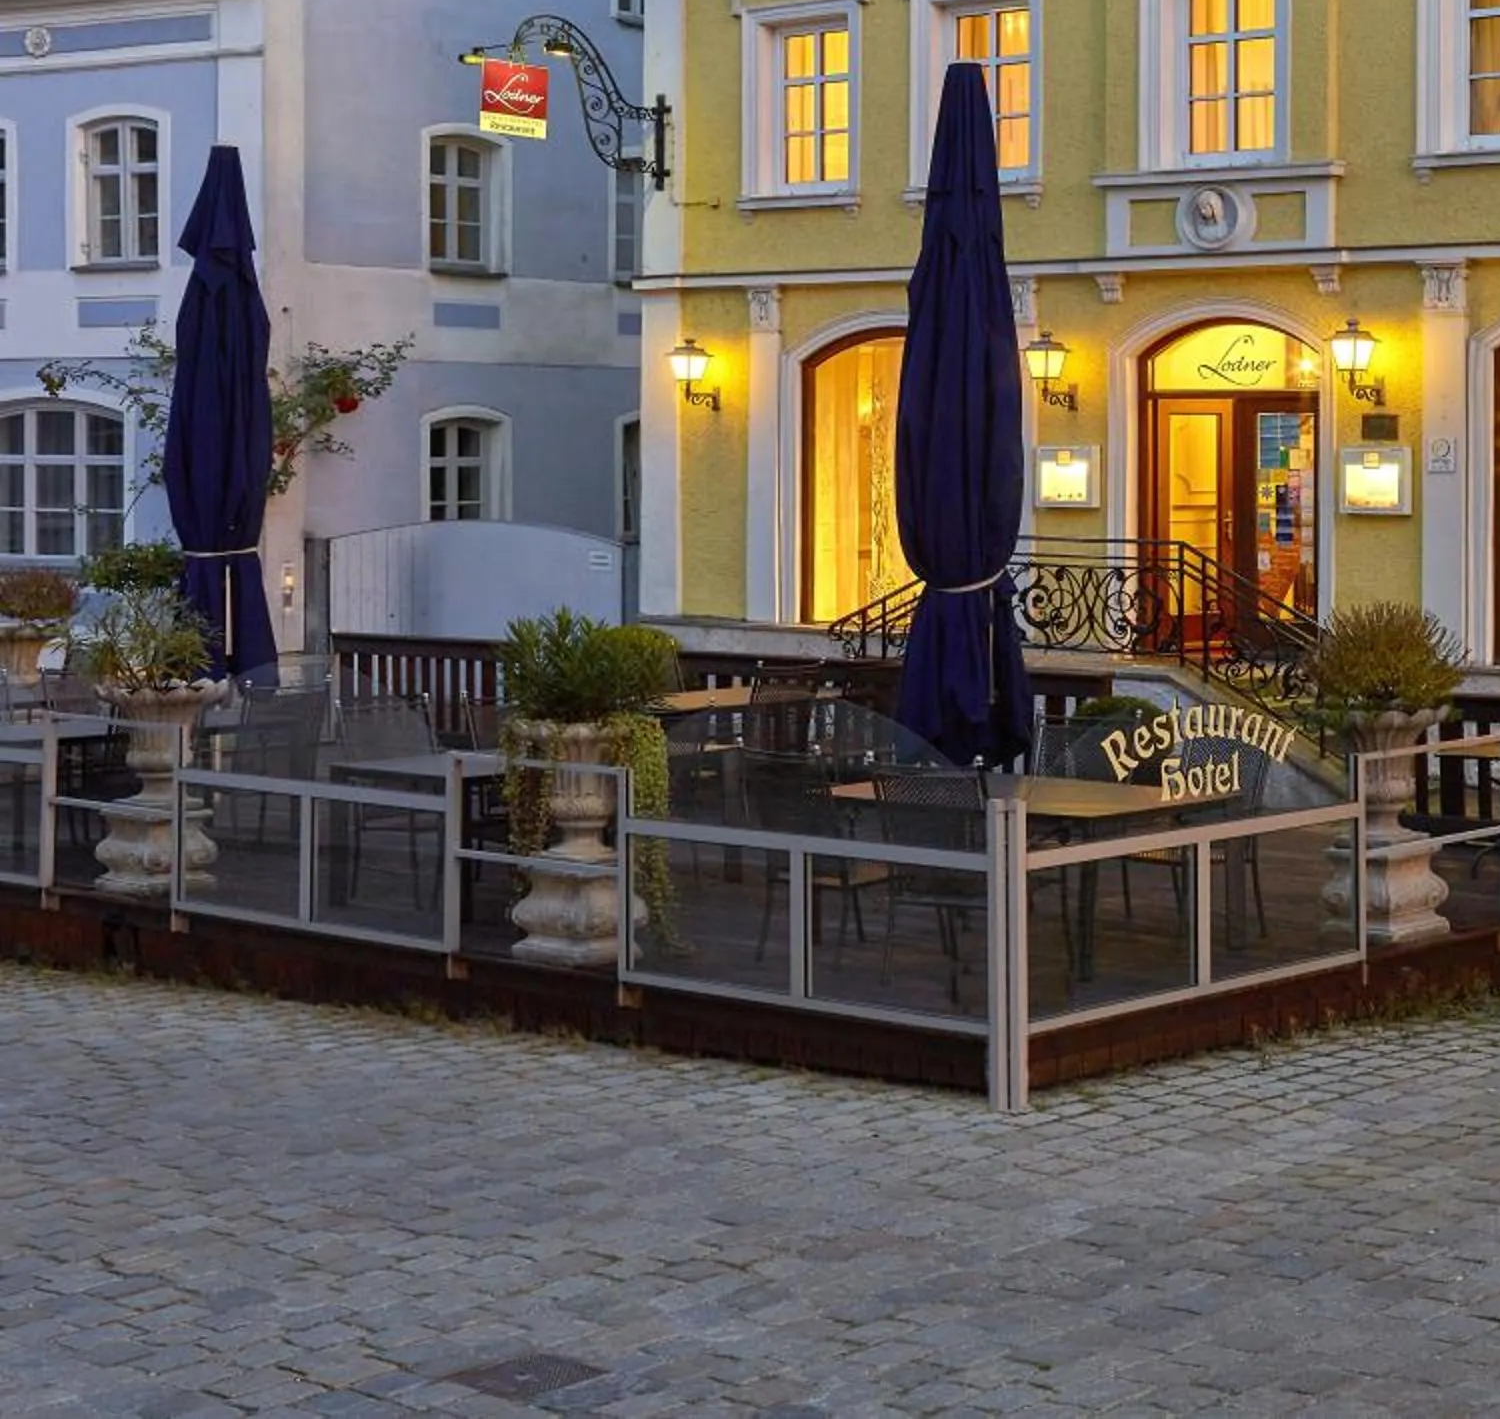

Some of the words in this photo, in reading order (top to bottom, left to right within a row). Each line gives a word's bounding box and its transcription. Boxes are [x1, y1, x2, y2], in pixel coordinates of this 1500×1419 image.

[484, 73, 544, 114] Lodner
[1197, 334, 1277, 386] Lodner
[1101, 694, 1298, 782] Restaurant
[1161, 750, 1241, 801] Hotel
